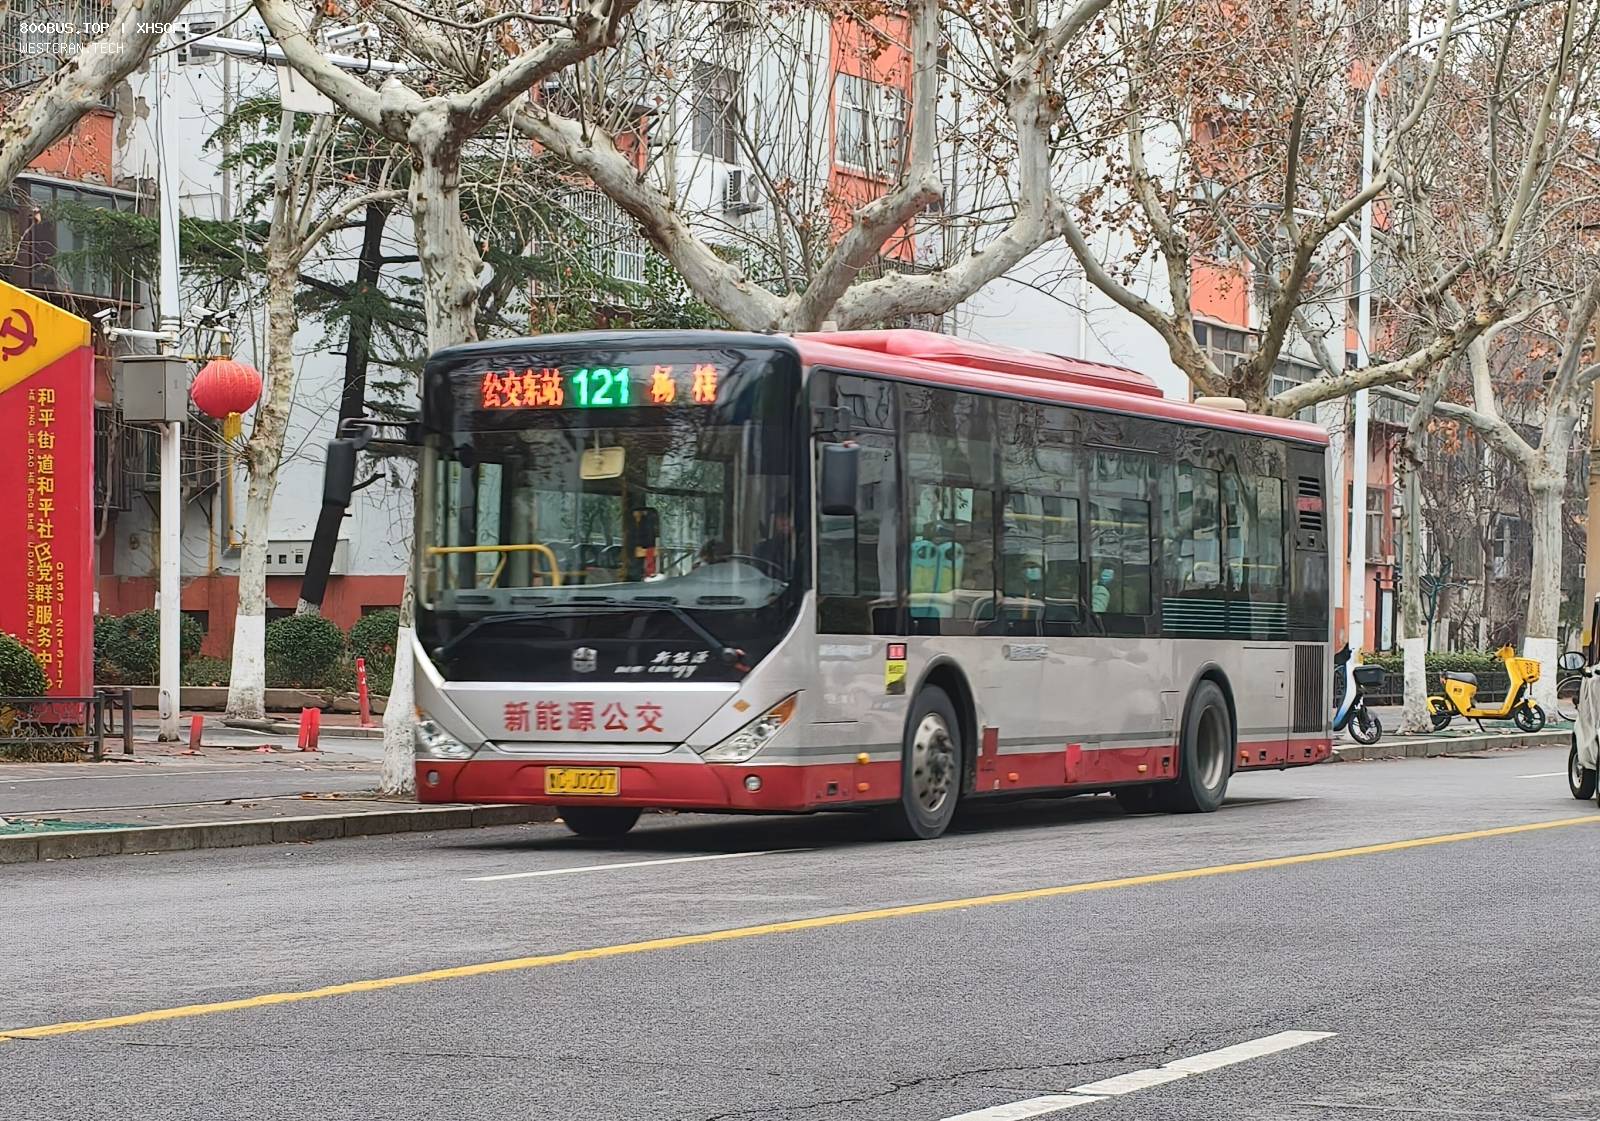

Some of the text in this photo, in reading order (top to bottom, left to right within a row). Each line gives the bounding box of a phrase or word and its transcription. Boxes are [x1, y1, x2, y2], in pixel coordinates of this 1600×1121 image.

[482, 367, 564, 409] 公交东站
[572, 367, 630, 406] 121
[504, 701, 664, 733] 新能源公交
